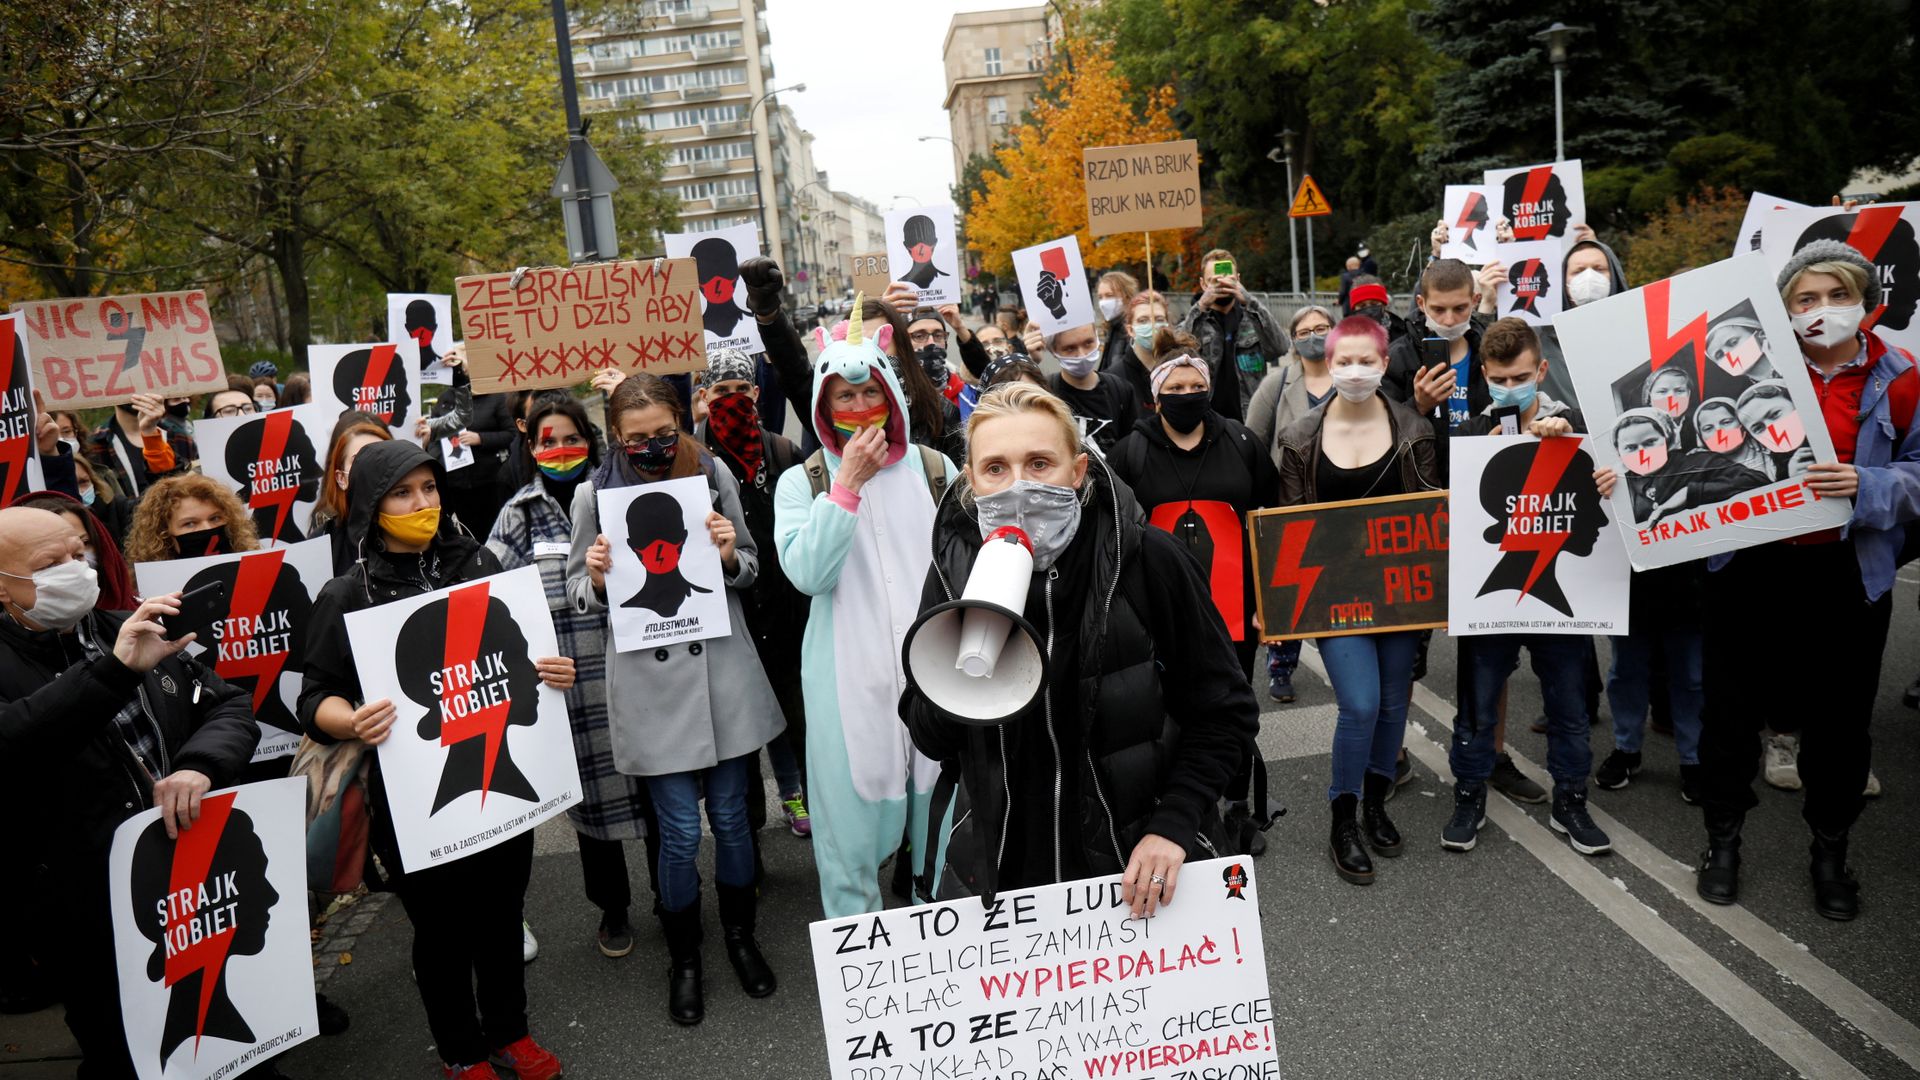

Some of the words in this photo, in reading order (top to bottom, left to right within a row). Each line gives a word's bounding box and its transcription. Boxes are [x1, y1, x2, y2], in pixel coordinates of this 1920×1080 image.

[1088, 158, 1128, 182] RZĄD
[1132, 156, 1152, 177] NA
[1155, 153, 1193, 175] BRUK
[1091, 194, 1131, 217] BRUK
[1135, 192, 1155, 210] NA
[1159, 187, 1196, 211] RZĄD
[1512, 199, 1555, 216] STRAJK
[1514, 213, 1554, 228] KOBIET
[461, 263, 673, 312] ZEBRALIŚMY
[99, 299, 129, 336] O
[140, 292, 210, 335] NAS
[467, 311, 516, 344] SIĘ
[514, 305, 559, 338] TU
[573, 296, 631, 330] DZIŚ
[646, 290, 694, 323] ABY
[42, 352, 136, 400] BEZ
[140, 342, 219, 390] NAS
[1, 386, 28, 414] AJK
[352, 384, 397, 402] STRAJK
[0, 413, 30, 442] BIET
[247, 454, 302, 478] STRAJK
[251, 472, 301, 496] KOBIET
[1505, 492, 1577, 514] STRAJK
[1364, 502, 1449, 557] JEBAĆ
[1507, 514, 1575, 536] KOBIET
[1638, 511, 1711, 546] STRAJK
[1383, 563, 1434, 605] PIS
[211, 609, 292, 640] STRAJK
[645, 616, 699, 634] #TOJESTWOJNA
[1329, 596, 1375, 629] OPÓR
[1468, 622, 1478, 630] NIE
[1479, 622, 1490, 630] DLA
[1491, 620, 1530, 629] ZAOSTRZENIA
[1531, 620, 1556, 628] USTAWY
[1558, 621, 1614, 630] ANTYABORCYJNEJ
[217, 632, 291, 662] KOBIET
[429, 650, 508, 696] STRAJK
[438, 678, 511, 724] KOBIET
[263, 743, 290, 756] USTAWY
[430, 848, 444, 861] NIE
[443, 843, 459, 855] DLA
[458, 825, 503, 850] ZAOSTRZENIA
[503, 812, 528, 832] USTAWY
[528, 790, 572, 820] ANTYABORCYJNEJ
[156, 870, 240, 927] STRAJK
[163, 902, 239, 960] KOBIET
[832, 916, 892, 955] ZA
[909, 906, 960, 940] TO
[1066, 882, 1123, 916] LUD
[1025, 915, 1156, 960] ZAMIAST
[845, 978, 962, 1024] SCALAĆ
[1162, 996, 1273, 1041] CHCECIE
[846, 1029, 893, 1061] ZA
[910, 1021, 956, 1051] TO
[1025, 985, 1152, 1033] ZAMIAST
[212, 1058, 239, 1080] USTAWY
[240, 1026, 302, 1065] ANTYABORCYJNEJ
